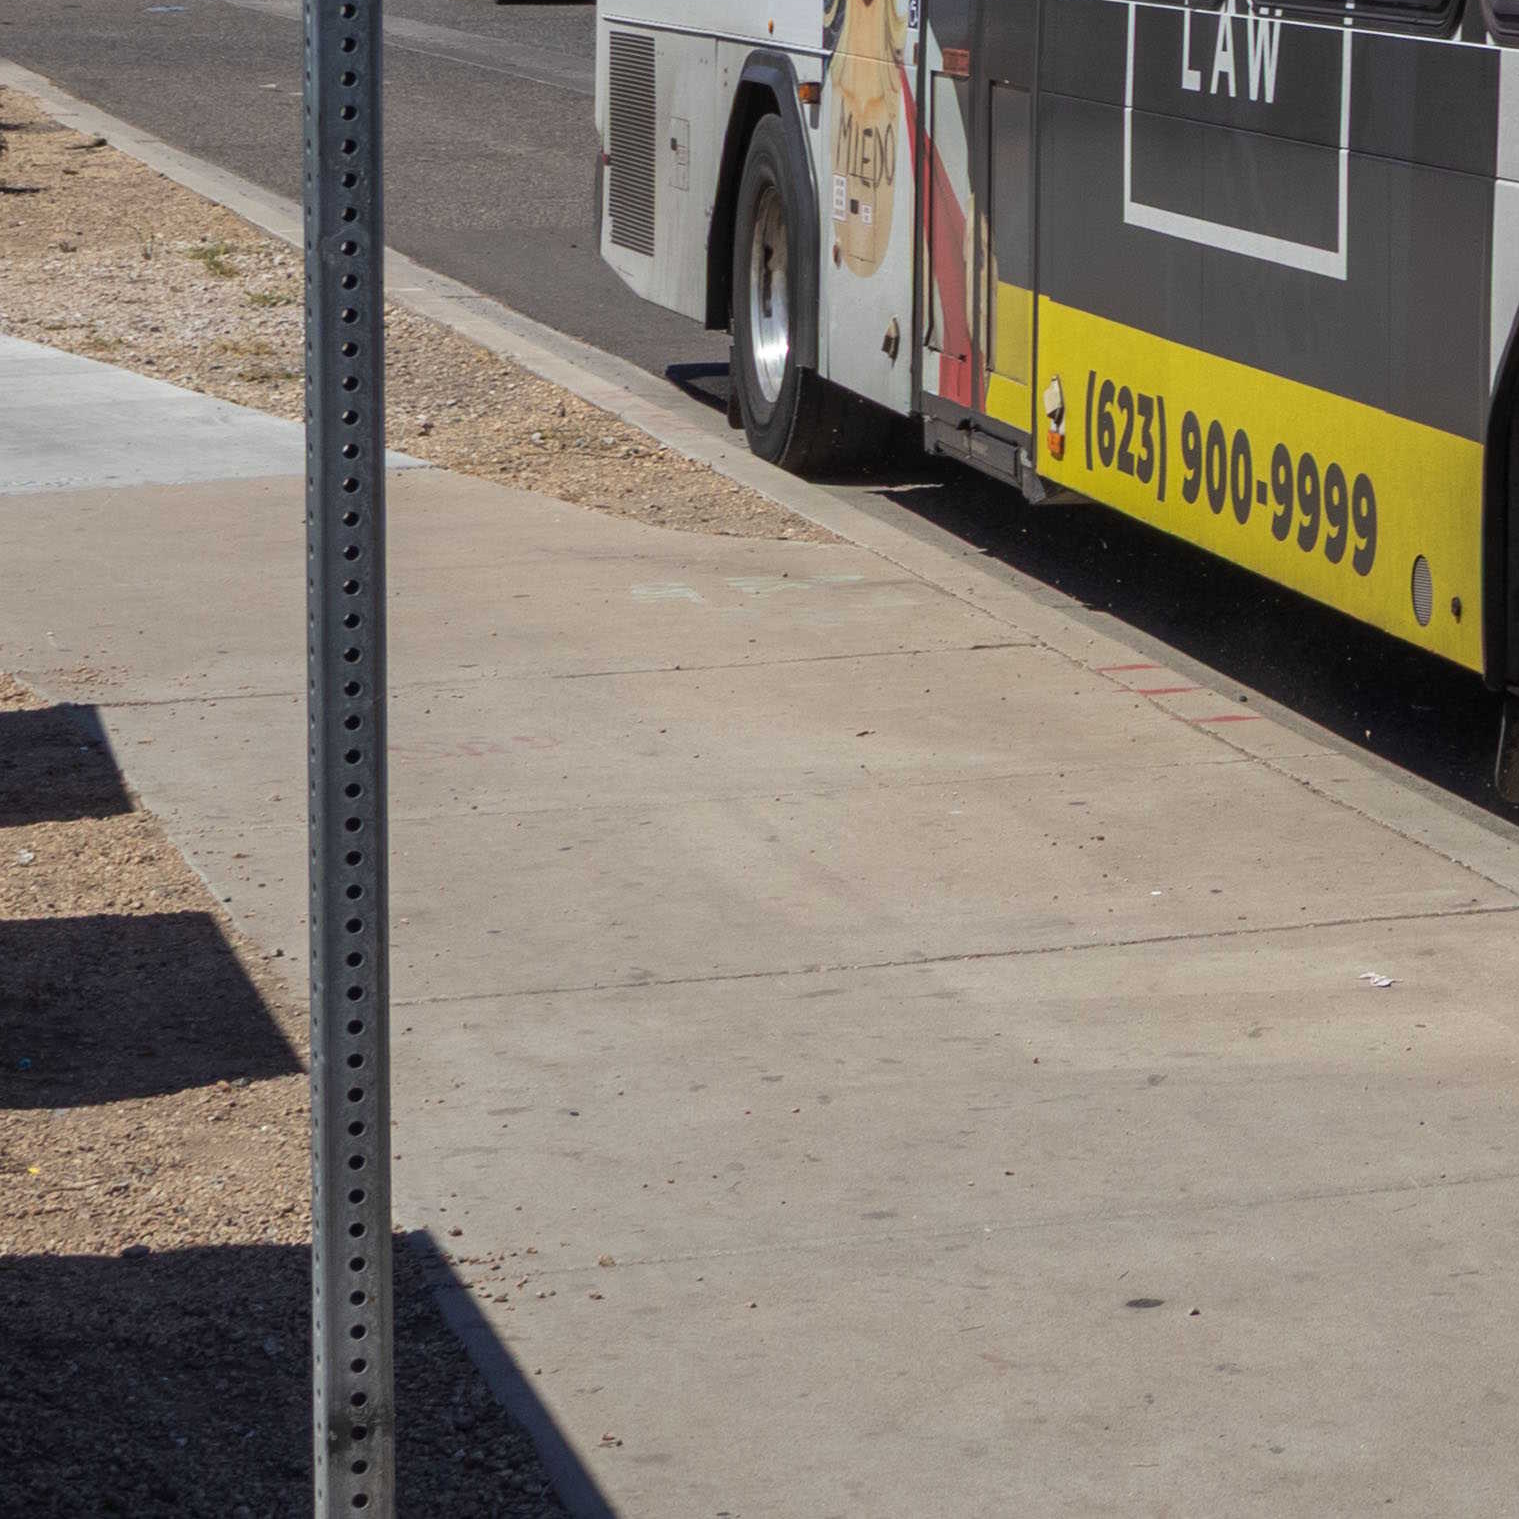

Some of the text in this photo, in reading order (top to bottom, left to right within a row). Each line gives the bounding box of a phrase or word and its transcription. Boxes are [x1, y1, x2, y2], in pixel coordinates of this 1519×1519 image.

[835, 105, 896, 191] MIEDO
[1085, 370, 1378, 577] (623) 900-9999
